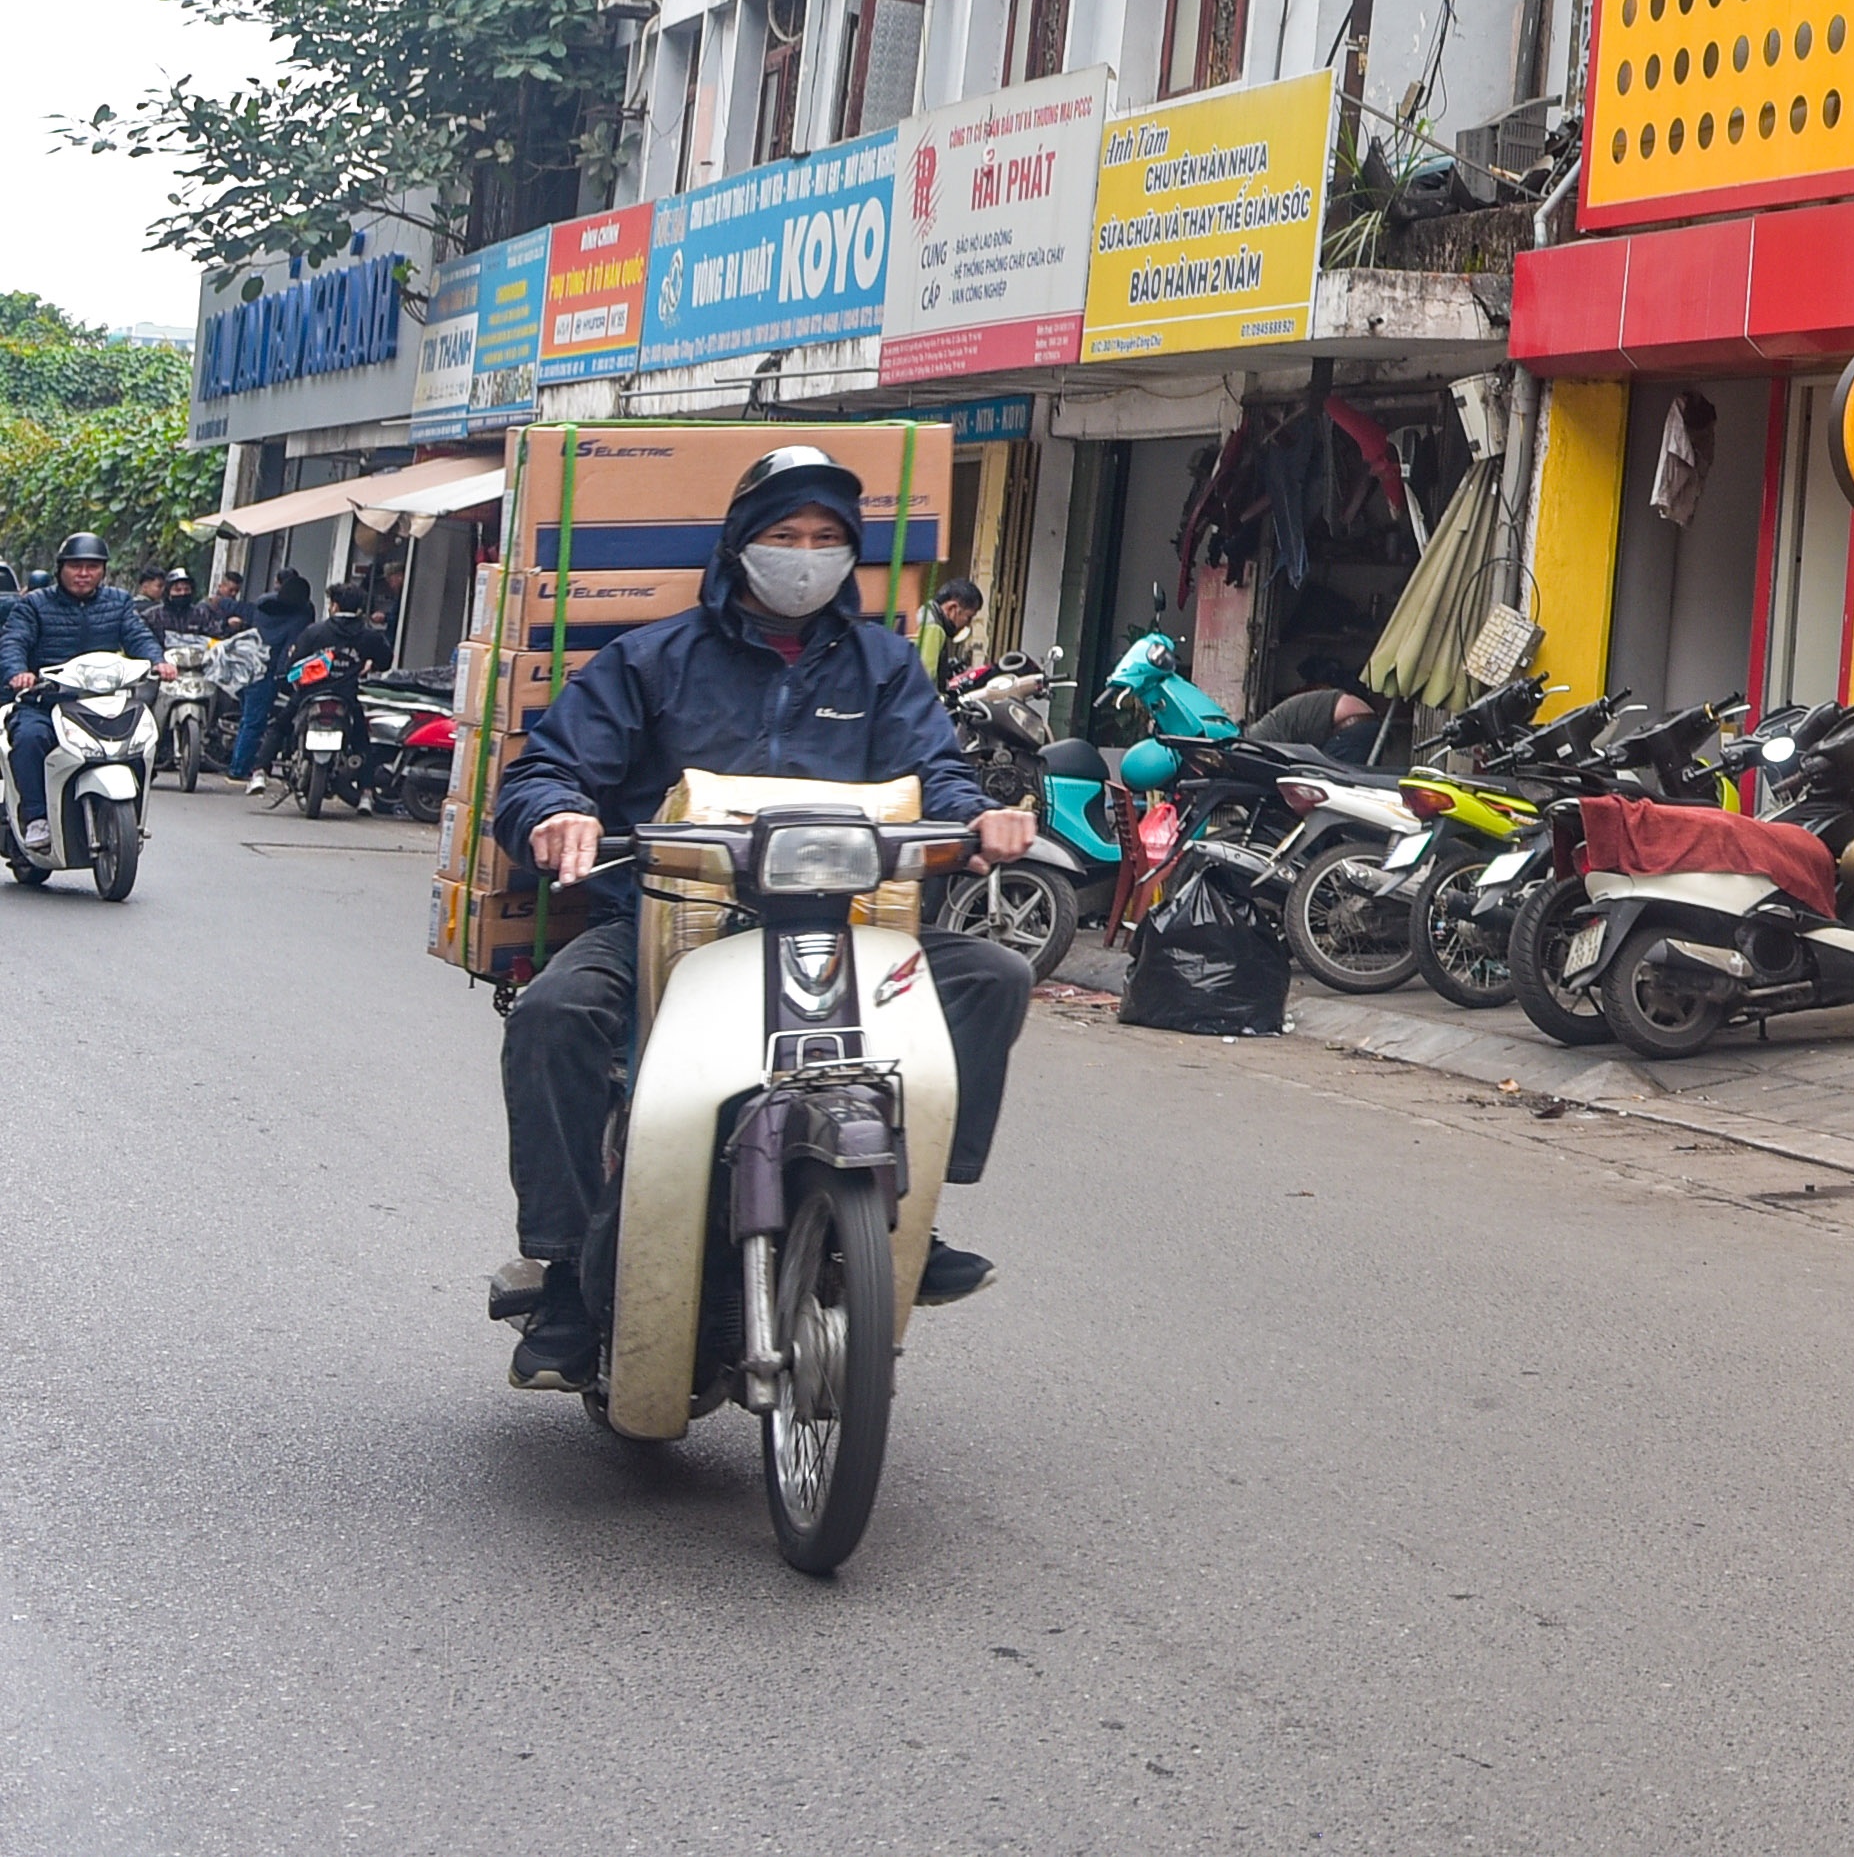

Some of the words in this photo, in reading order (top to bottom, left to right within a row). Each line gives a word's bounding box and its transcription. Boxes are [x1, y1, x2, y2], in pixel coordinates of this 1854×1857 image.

[1104, 130, 1133, 165] Anh
[1137, 123, 1168, 158] Tâm
[971, 148, 1002, 211] HẢI
[1006, 143, 1056, 205] PHÁT
[1145, 152, 1196, 193] CHUYÊN
[1199, 145, 1226, 181] HÀN
[1229, 143, 1267, 182] NHỰA
[1126, 209, 1161, 246] CHỮA
[1164, 205, 1178, 241] VÀ
[1182, 206, 1216, 238] THAY
[1217, 184, 1247, 231] THẾ
[1281, 183, 1311, 221] SÓC
[692, 253, 723, 307] VÒNG
[724, 253, 739, 300] BI
[740, 237, 775, 302] NHẬT
[778, 197, 885, 303] KOYO
[921, 240, 948, 270] CUNG
[980, 236, 992, 251] LAO
[1047, 244, 1065, 265] CHÁY
[1164, 255, 1208, 299] HÀNH
[1211, 259, 1222, 291] 2
[1223, 247, 1262, 290] NĂM
[921, 277, 941, 311] CẤP
[594, 446, 676, 458] ELECTRIC
[573, 587, 656, 599] ELECTRIC
